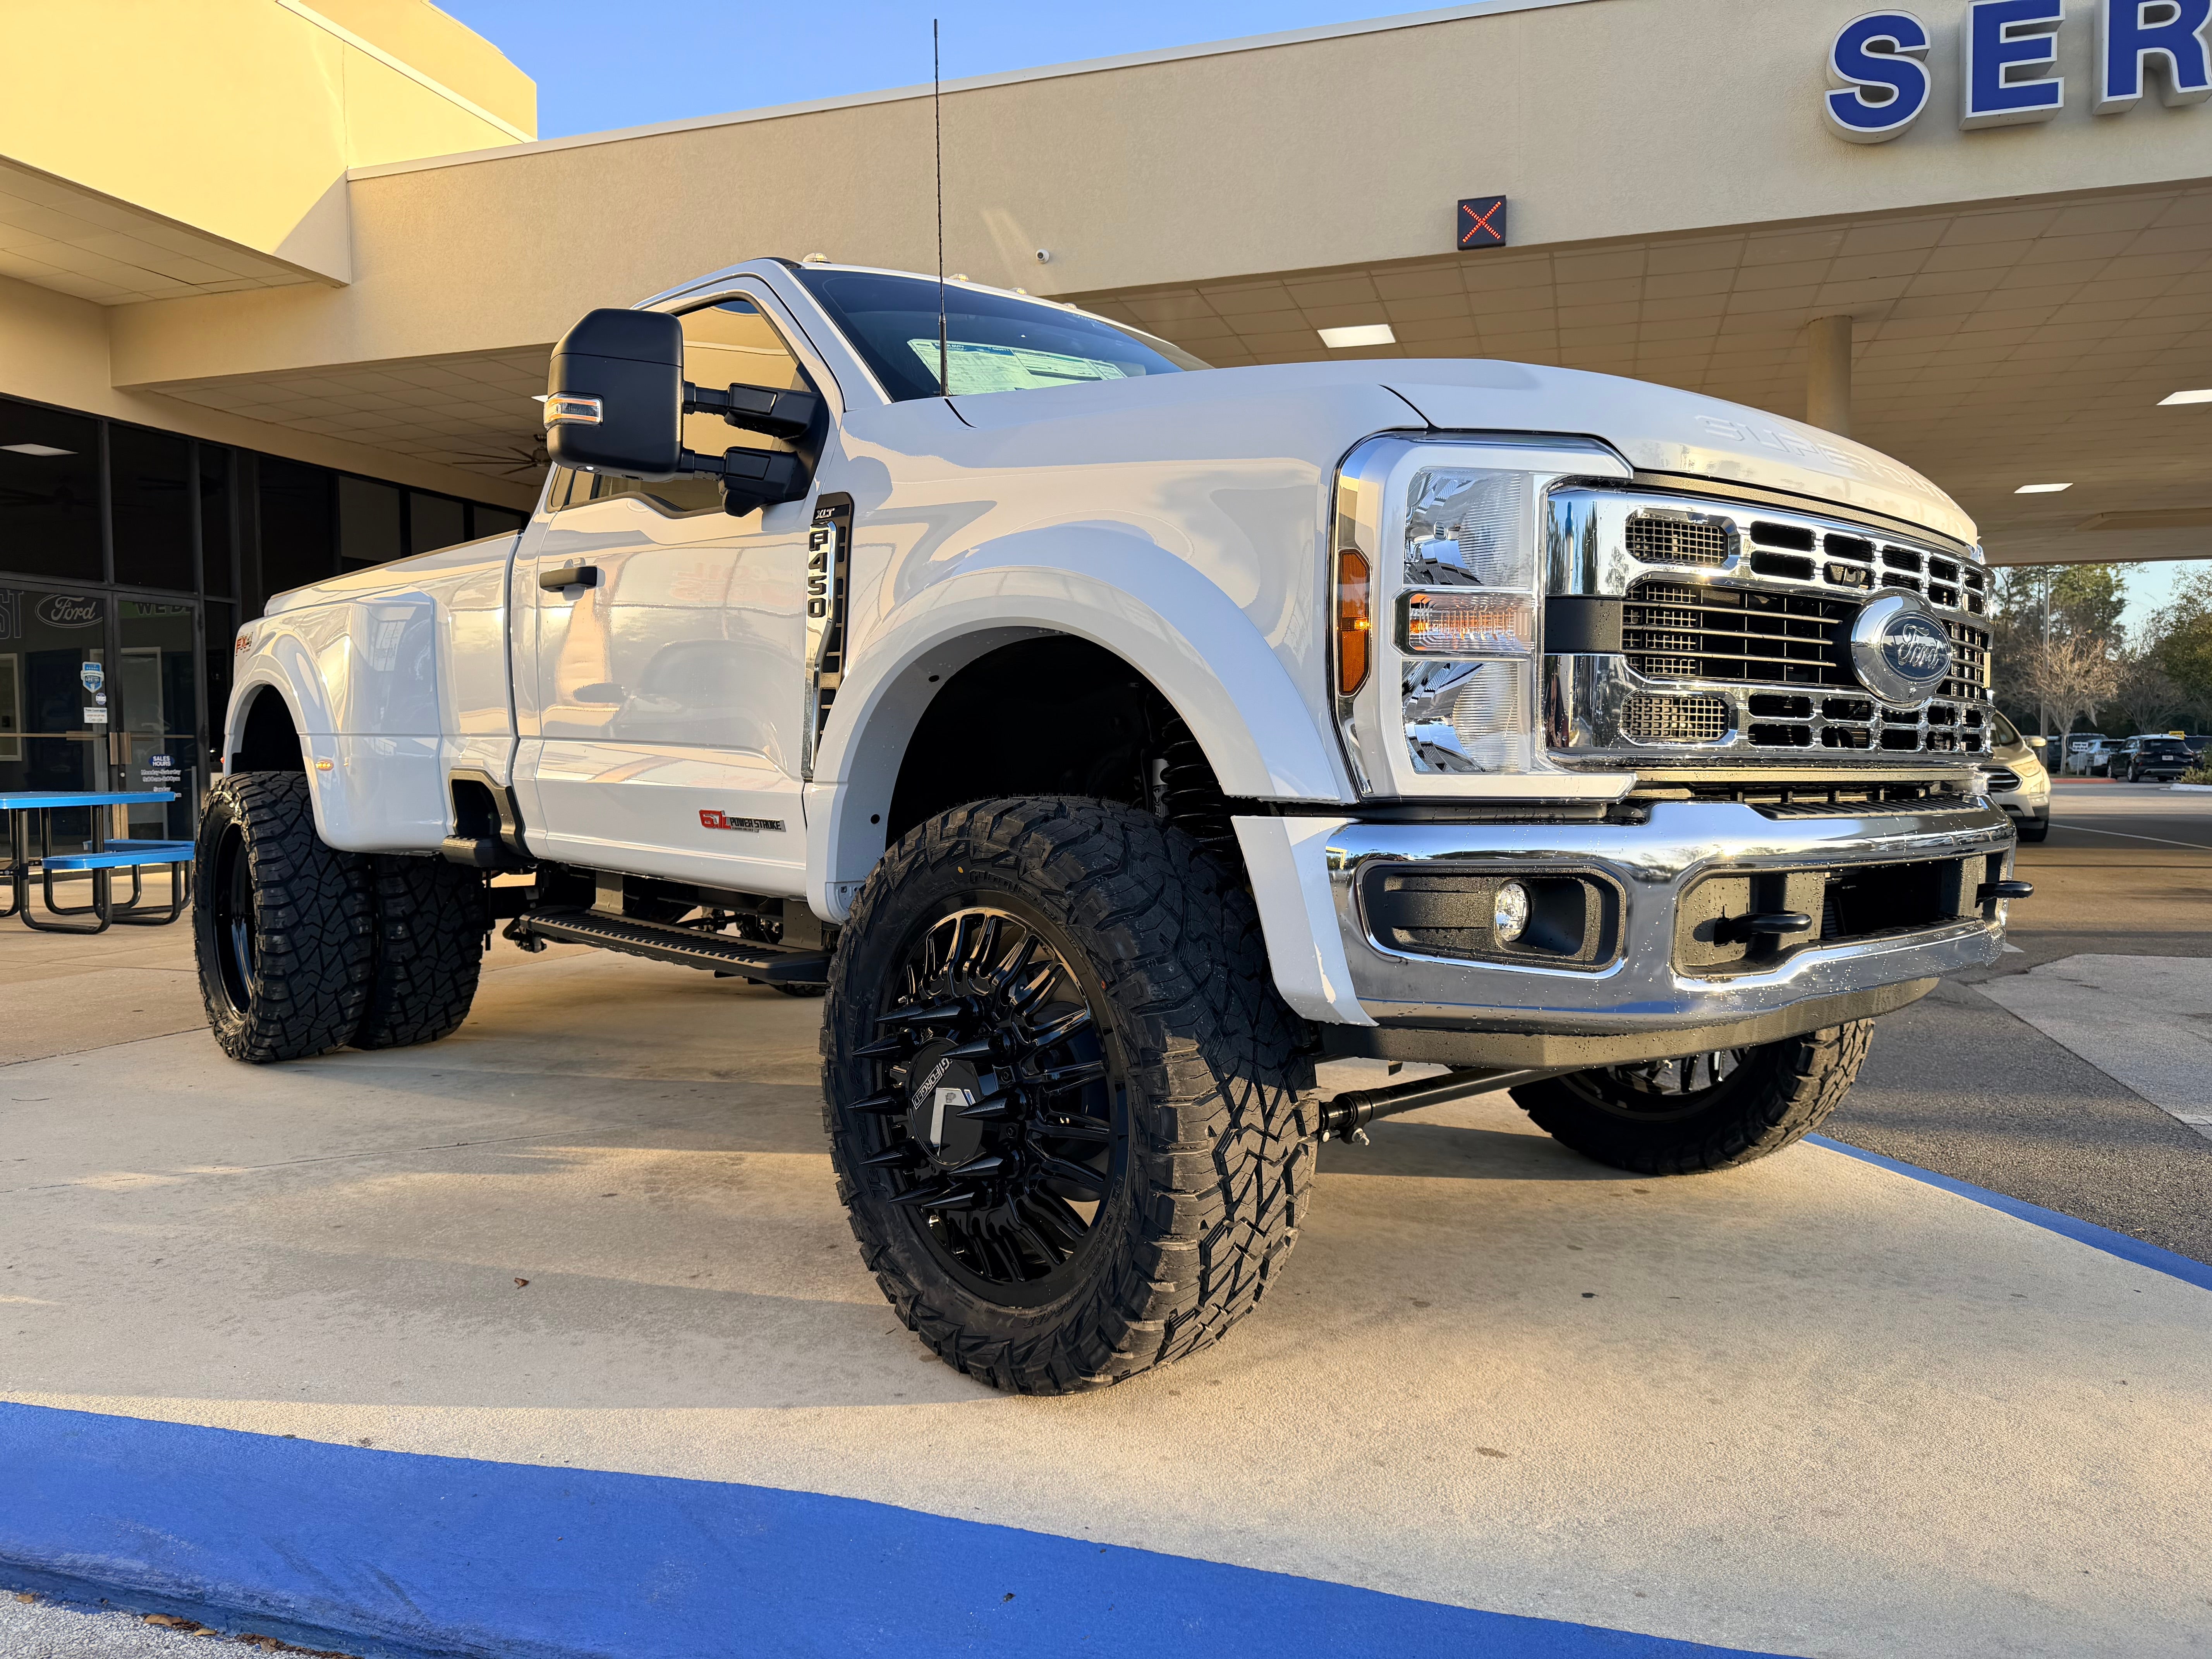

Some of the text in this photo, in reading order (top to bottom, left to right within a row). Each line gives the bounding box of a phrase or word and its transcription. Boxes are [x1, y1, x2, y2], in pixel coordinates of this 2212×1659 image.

[1825, 0, 2212, 137] SER
[816, 508, 835, 519] XLT
[51, 596, 96, 621] Ford
[1898, 623, 1940, 670] Ford
[730, 817, 754, 828] POWER
[755, 819, 781, 830] STROKE
[911, 1054, 954, 1108] G1 FORGED
